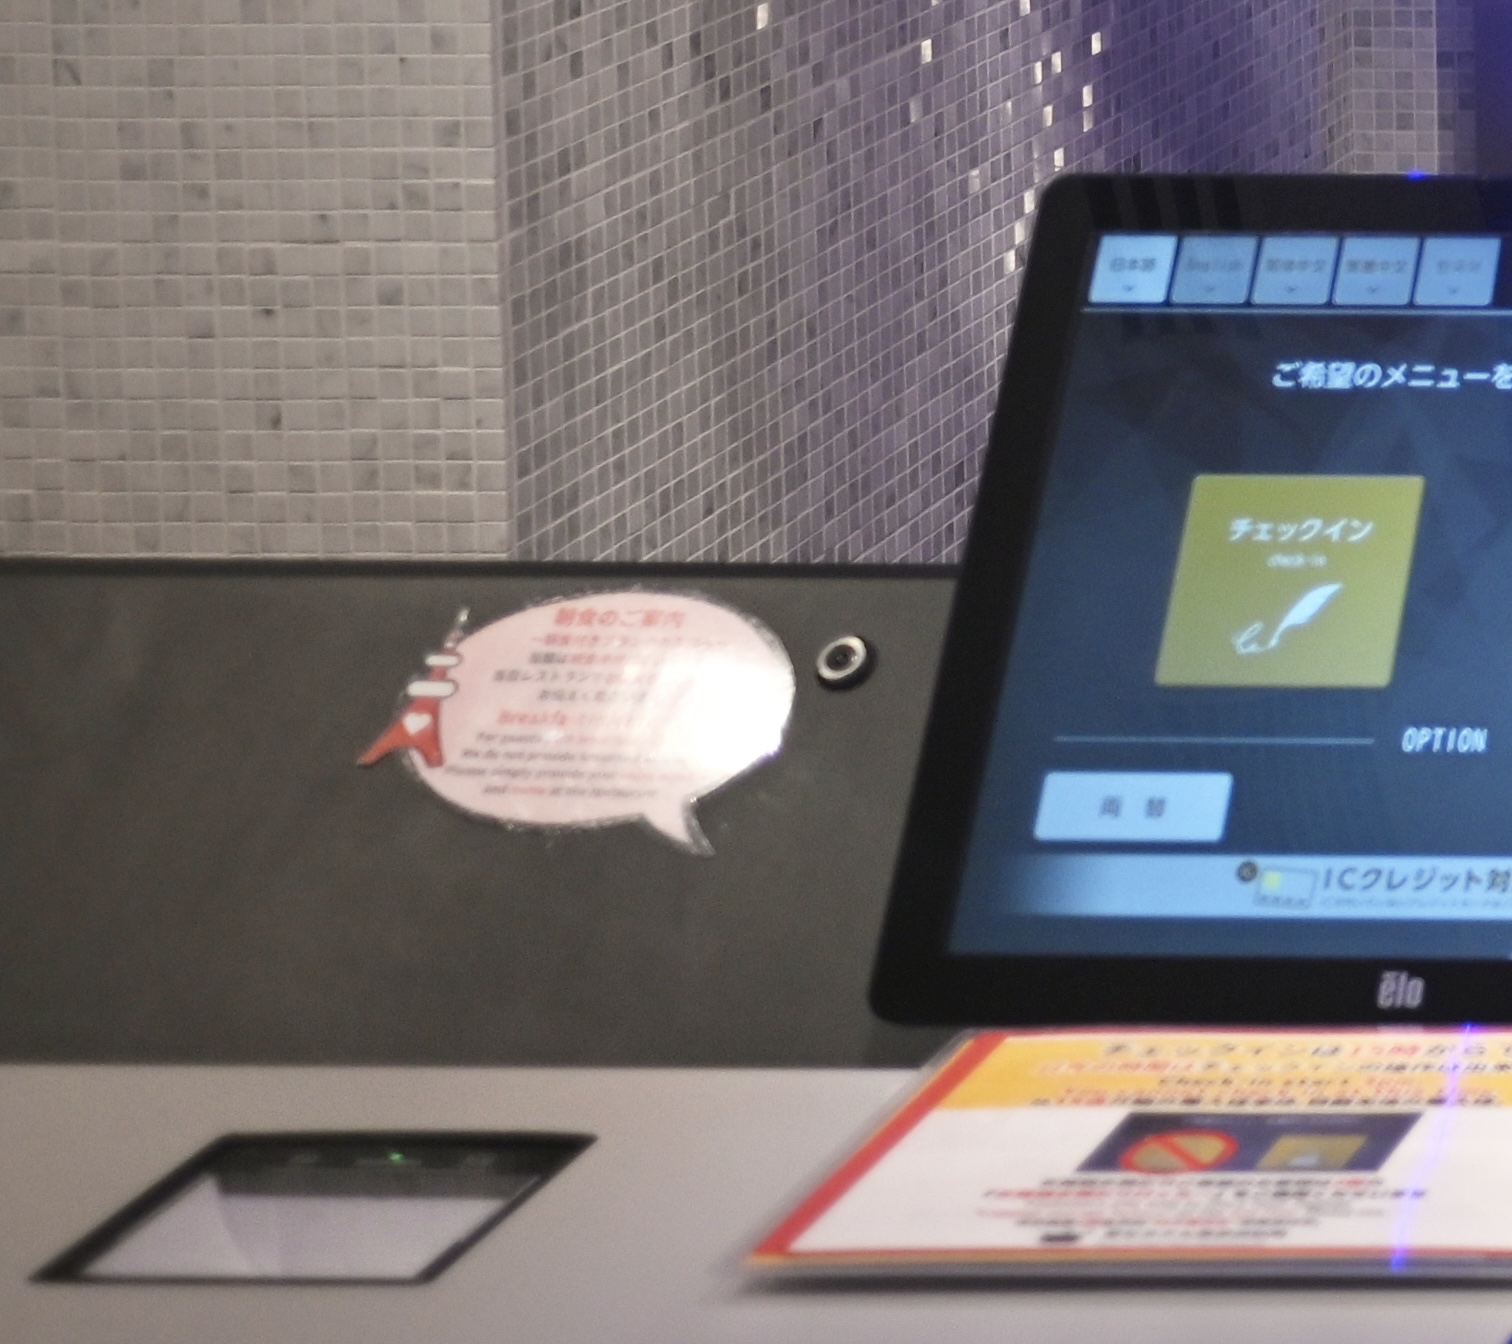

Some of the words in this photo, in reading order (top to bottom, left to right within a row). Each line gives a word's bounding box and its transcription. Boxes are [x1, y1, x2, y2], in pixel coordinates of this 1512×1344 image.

[1229, 518, 1374, 543] チェックイン
[1402, 728, 1488, 753] OPTION
